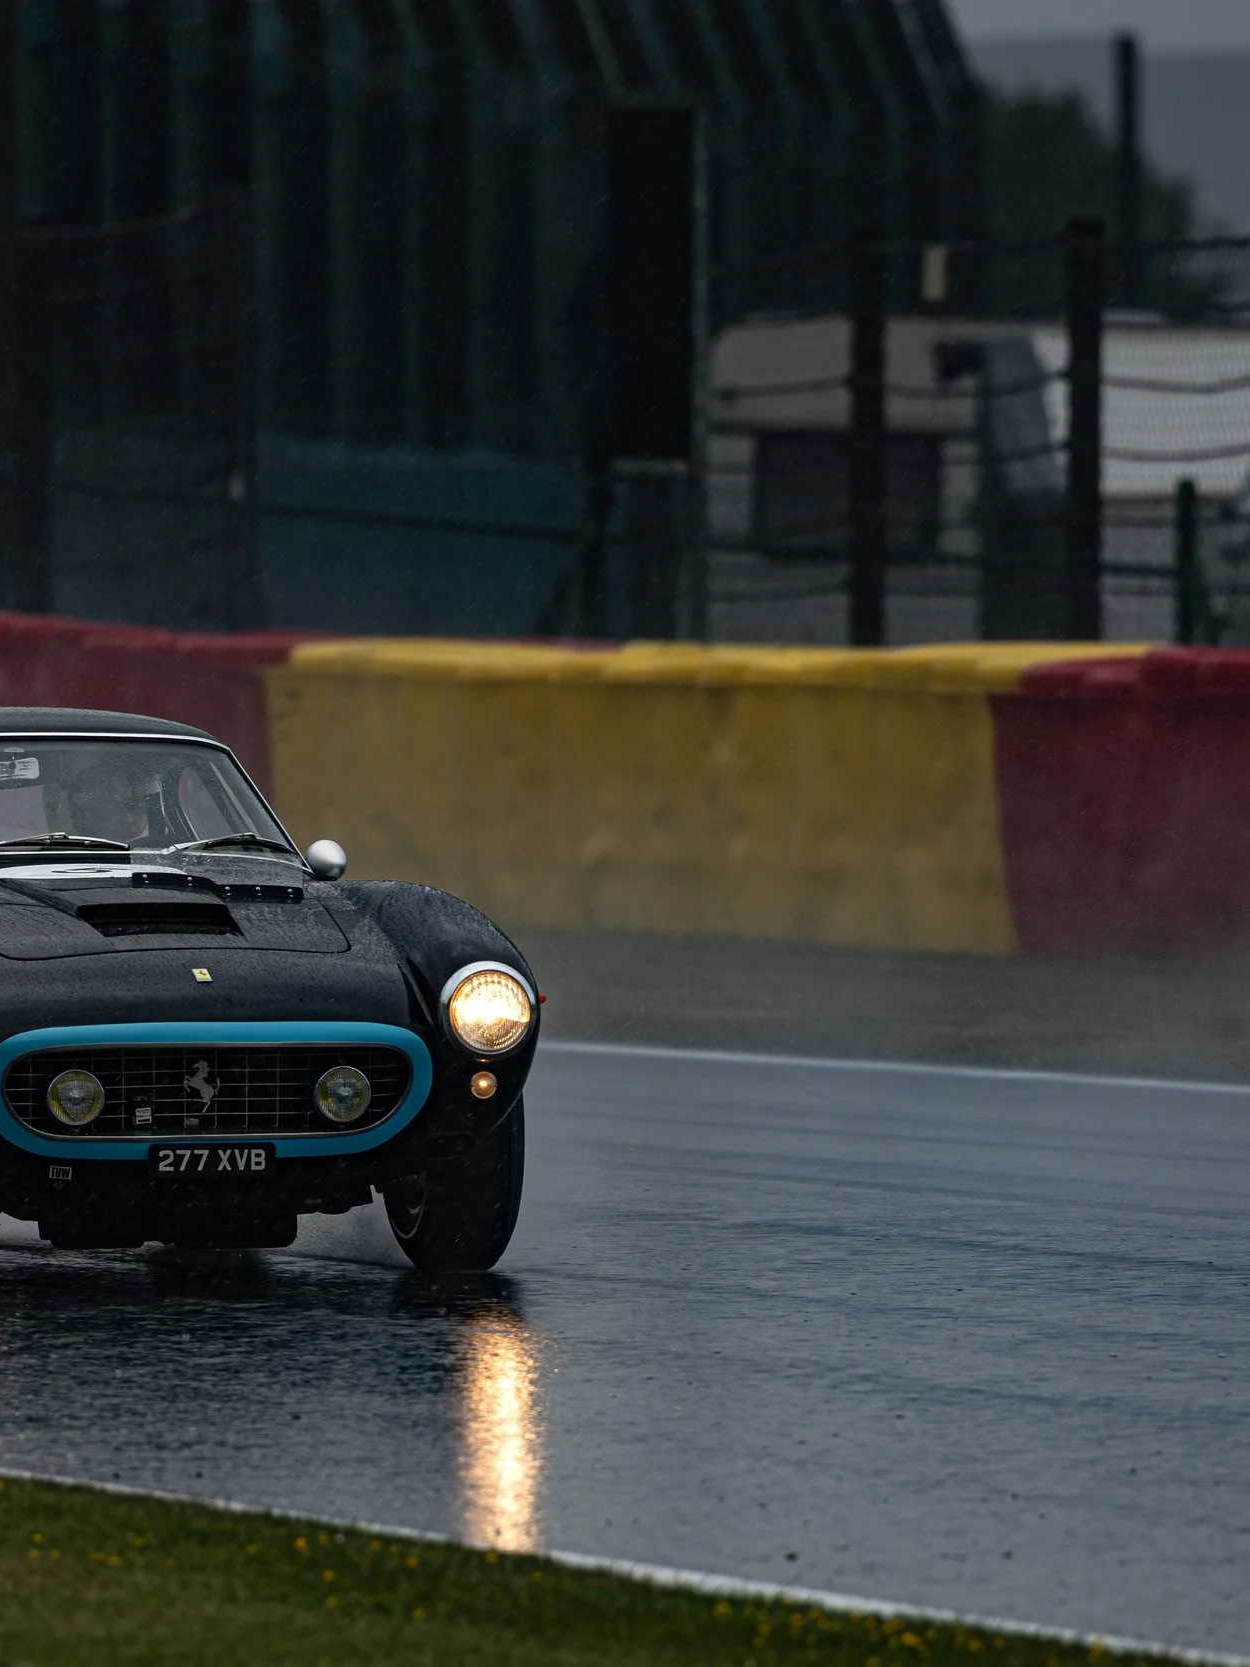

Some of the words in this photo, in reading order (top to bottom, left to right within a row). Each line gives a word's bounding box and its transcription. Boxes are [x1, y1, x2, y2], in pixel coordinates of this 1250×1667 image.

[158, 1149, 209, 1172] 277
[218, 1149, 266, 1171] XVB
[51, 1166, 71, 1178] TOW
